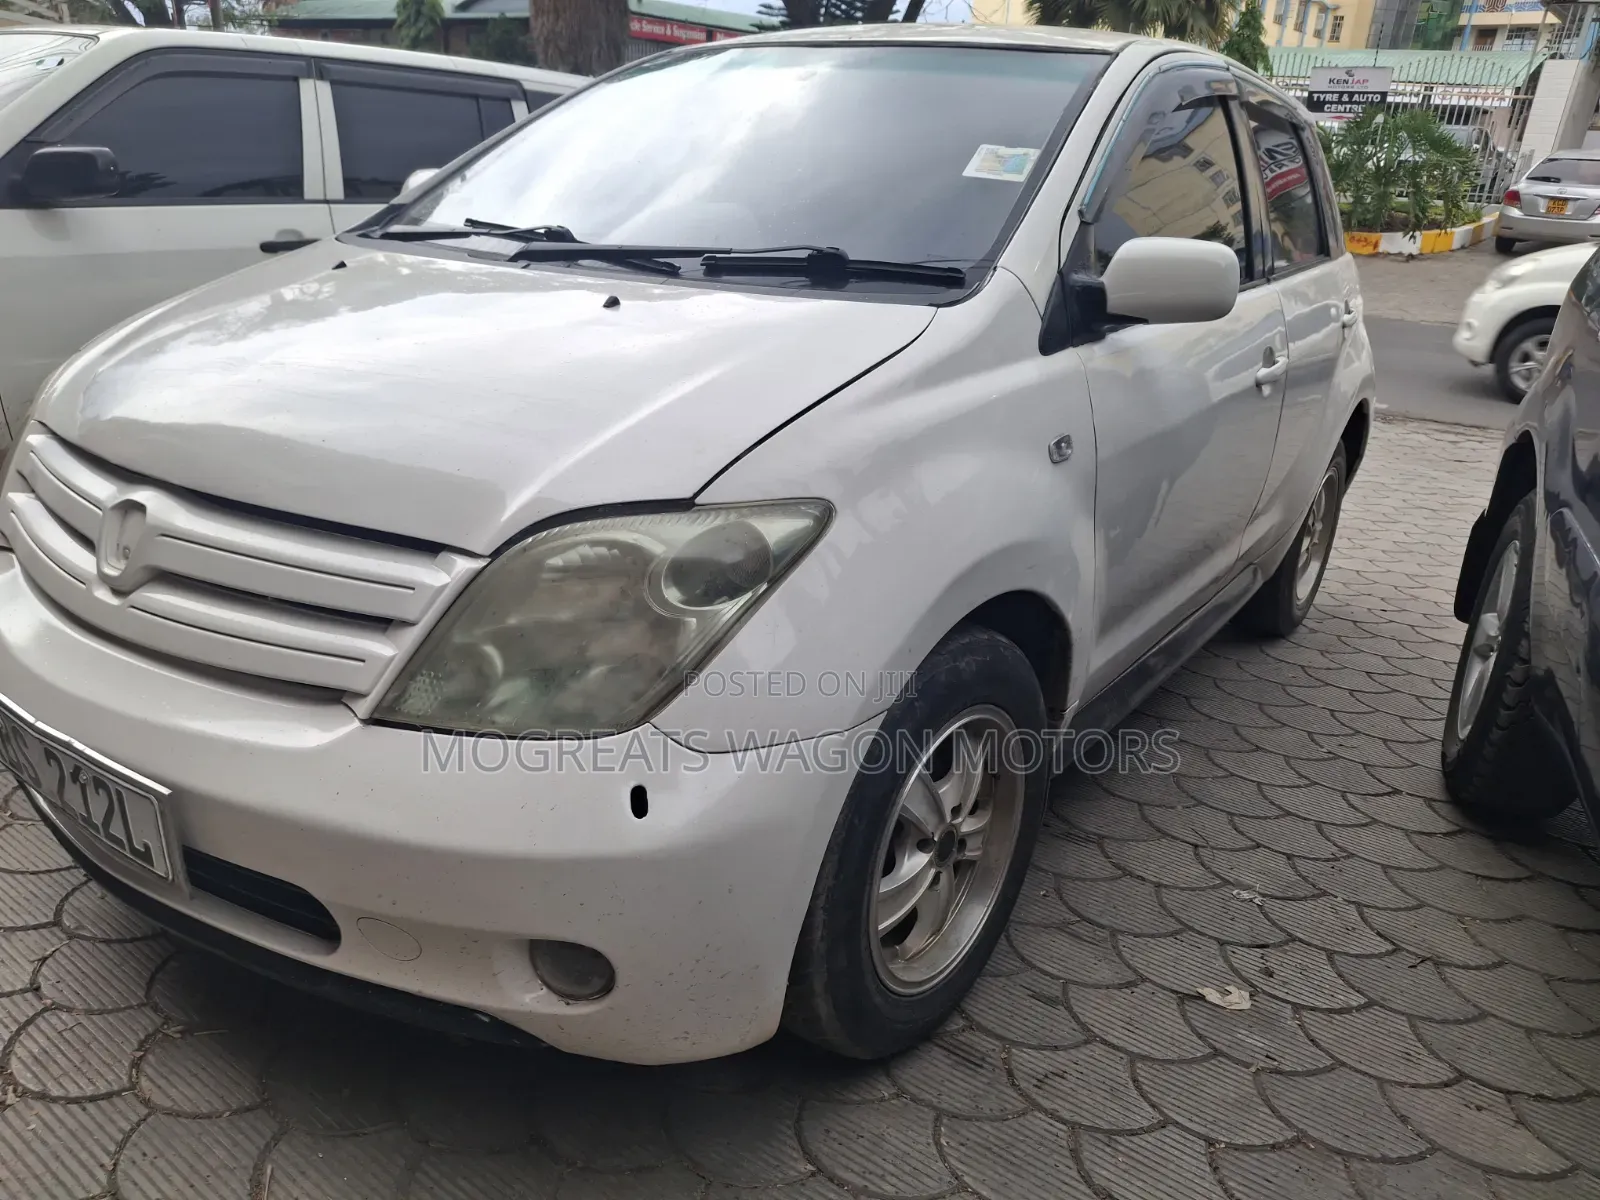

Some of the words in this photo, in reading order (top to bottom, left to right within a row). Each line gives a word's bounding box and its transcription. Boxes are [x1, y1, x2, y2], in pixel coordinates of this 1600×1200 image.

[1312, 93, 1339, 102] TYRE
[1341, 93, 1349, 102] &
[1352, 93, 1381, 102] AUTO
[44, 746, 156, 869] 212L
